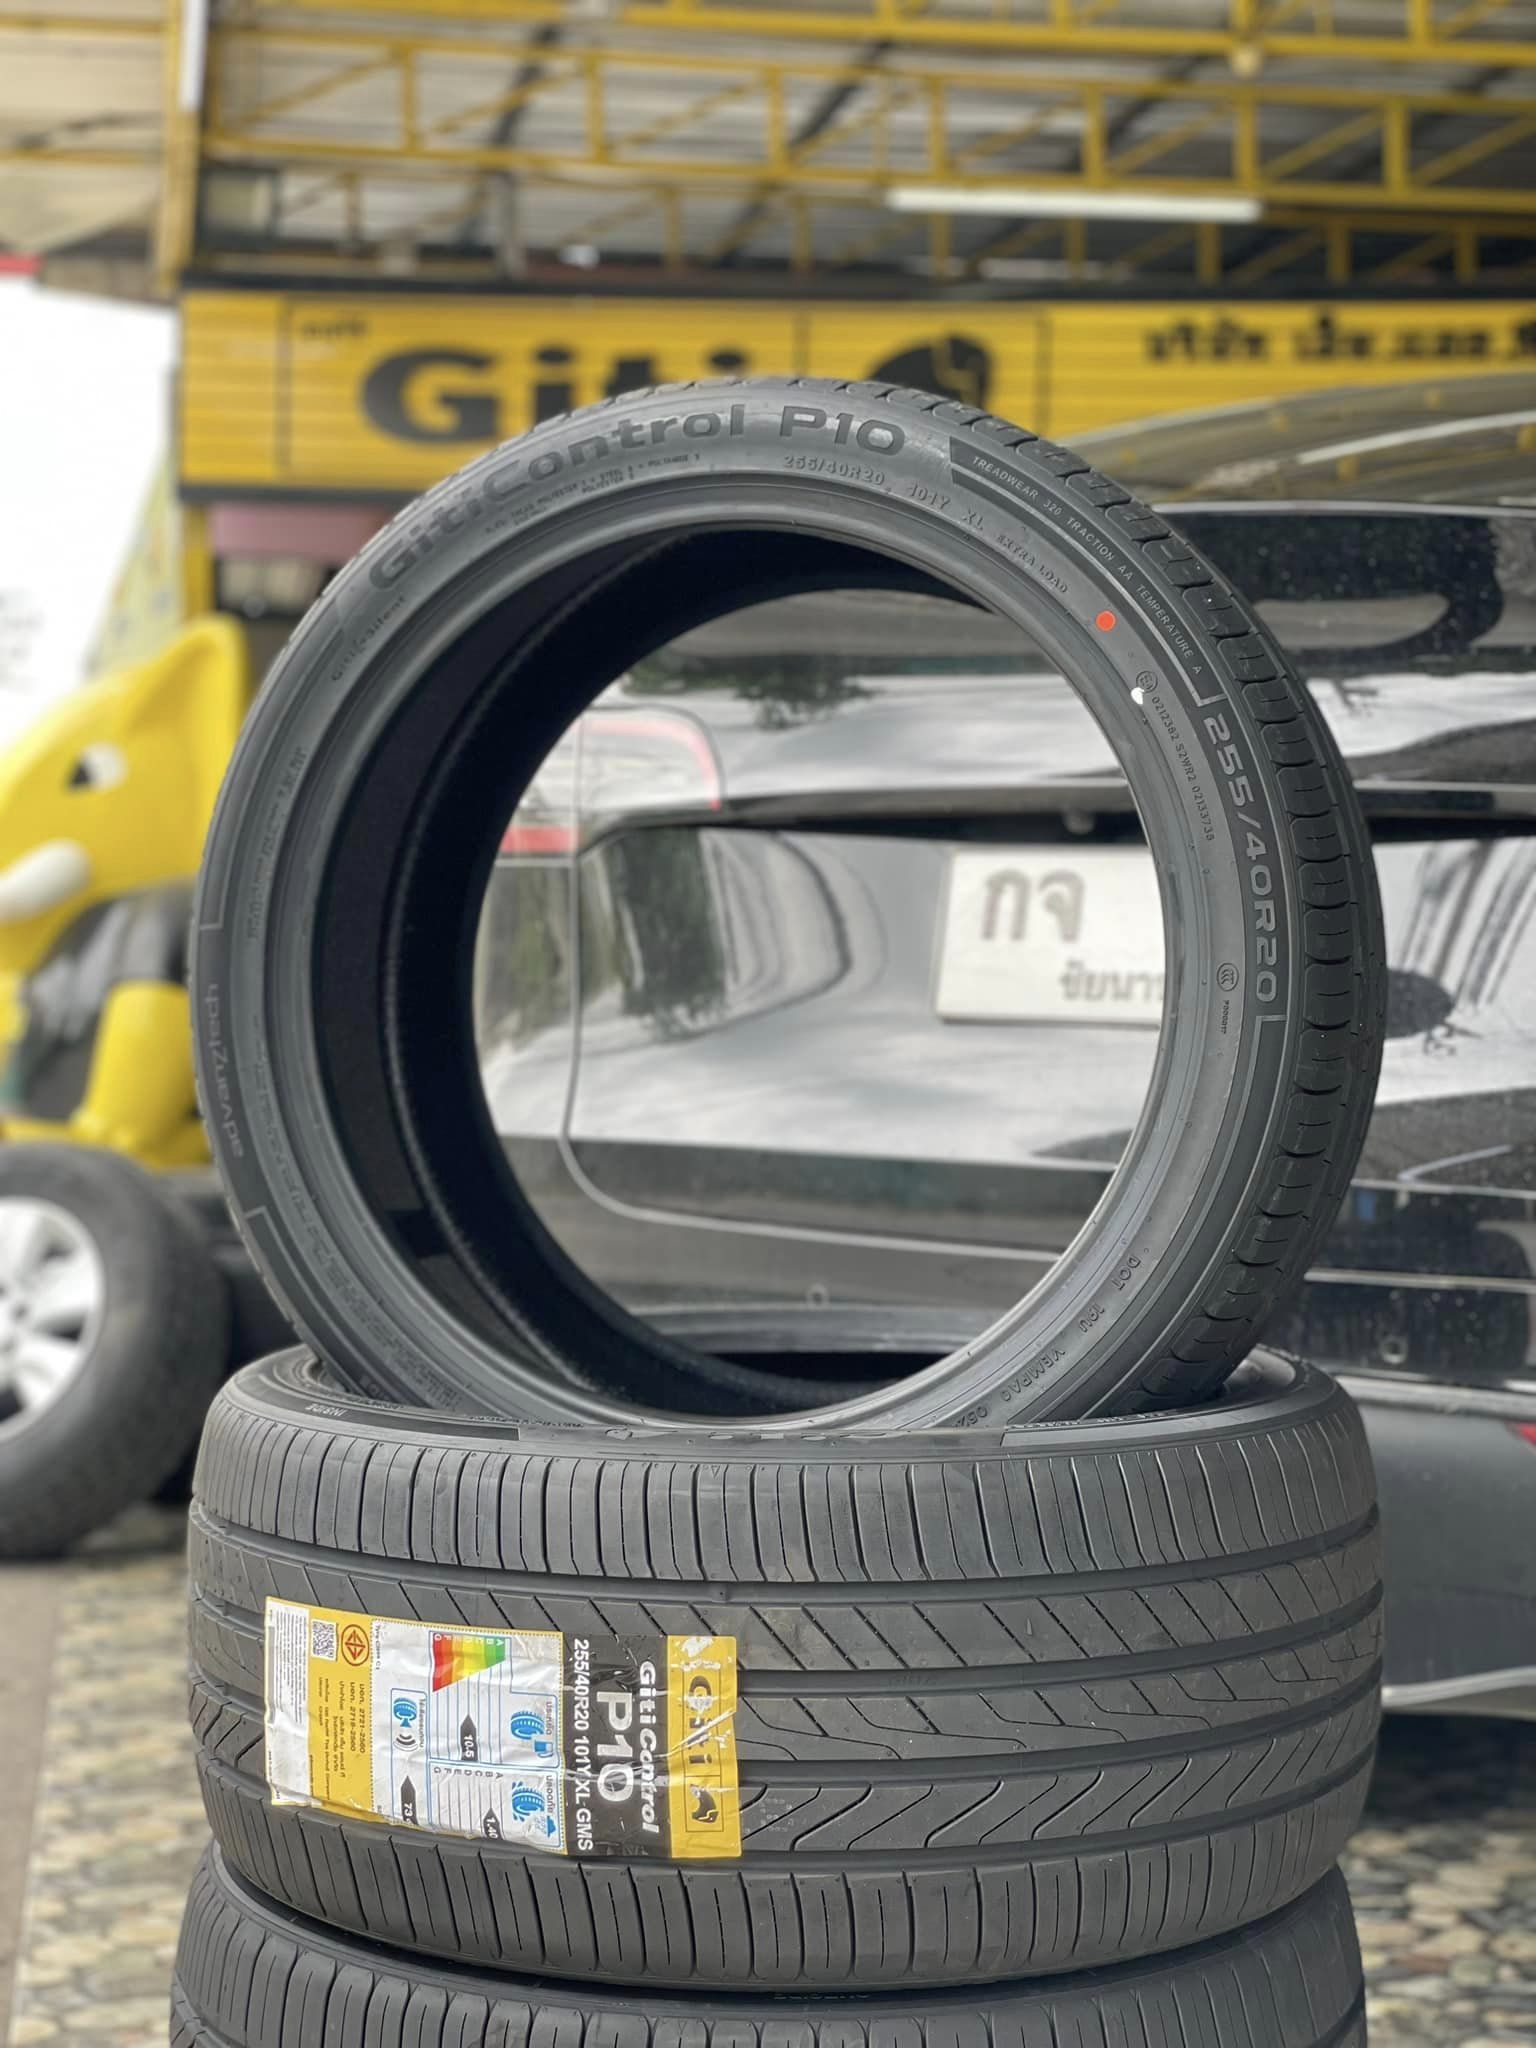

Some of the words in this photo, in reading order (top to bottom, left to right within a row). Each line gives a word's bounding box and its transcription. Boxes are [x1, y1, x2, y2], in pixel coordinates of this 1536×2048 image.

[368, 404, 746, 590] GitiControl
[779, 405, 905, 456] P10
[784, 454, 885, 487] 255/40R20
[908, 481, 950, 511] 101Y
[962, 508, 984, 533] XL
[1039, 565, 1068, 595] LOAD
[972, 455, 1040, 500] TREADWEAR
[1066, 516, 1116, 562] TRACTION
[1117, 564, 1133, 582] AA
[1136, 584, 1195, 660] TEMPERATURE
[1192, 664, 1203, 676] A
[1203, 712, 1278, 1003] 255/40R20
[1111, 1256, 1141, 1291] DOT
[574, 1638, 590, 1731] 255/40R20
[464, 1734, 475, 1758] 10.5
[596, 1691, 634, 1802] P10
[486, 1817, 499, 1840] 1.40
[575, 1808, 594, 1850] GMS
